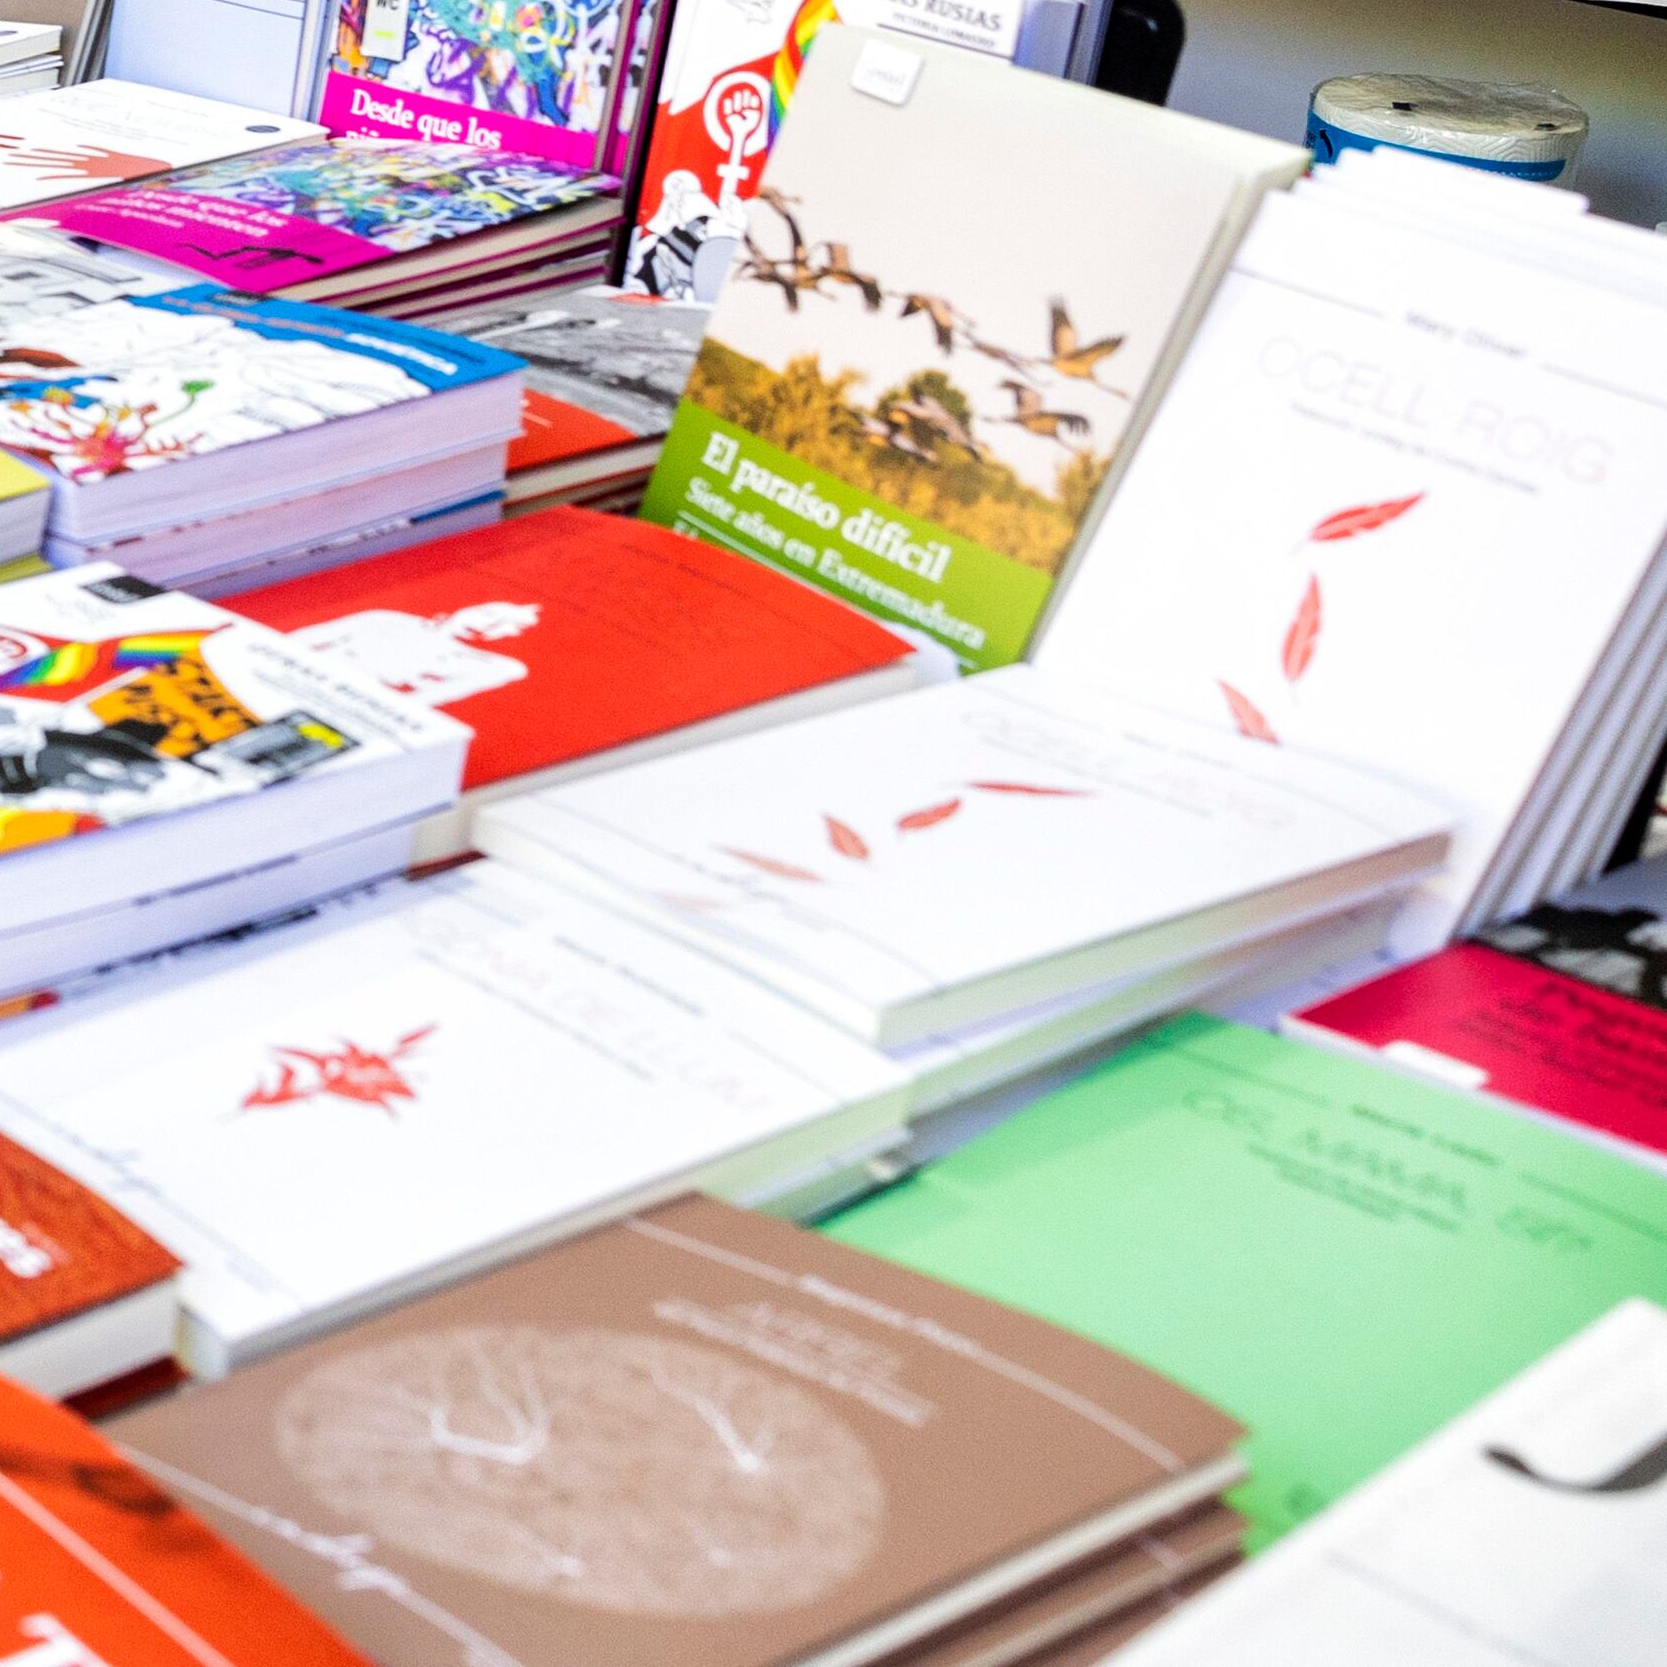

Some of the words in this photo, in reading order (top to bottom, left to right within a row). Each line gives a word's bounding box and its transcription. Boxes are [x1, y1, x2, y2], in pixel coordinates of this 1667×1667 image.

[349, 85, 414, 132] Desde
[416, 97, 461, 147] que
[464, 113, 503, 152] los
[1256, 334, 1448, 426] OCELL
[1455, 395, 1614, 488] ROIG
[685, 475, 735, 525] Siete
[731, 495, 784, 553] años
[783, 521, 818, 566] en
[814, 535, 987, 652] Extremadura
[701, 429, 739, 472] El
[731, 444, 842, 533] paraíso
[842, 505, 951, 586] difícil
